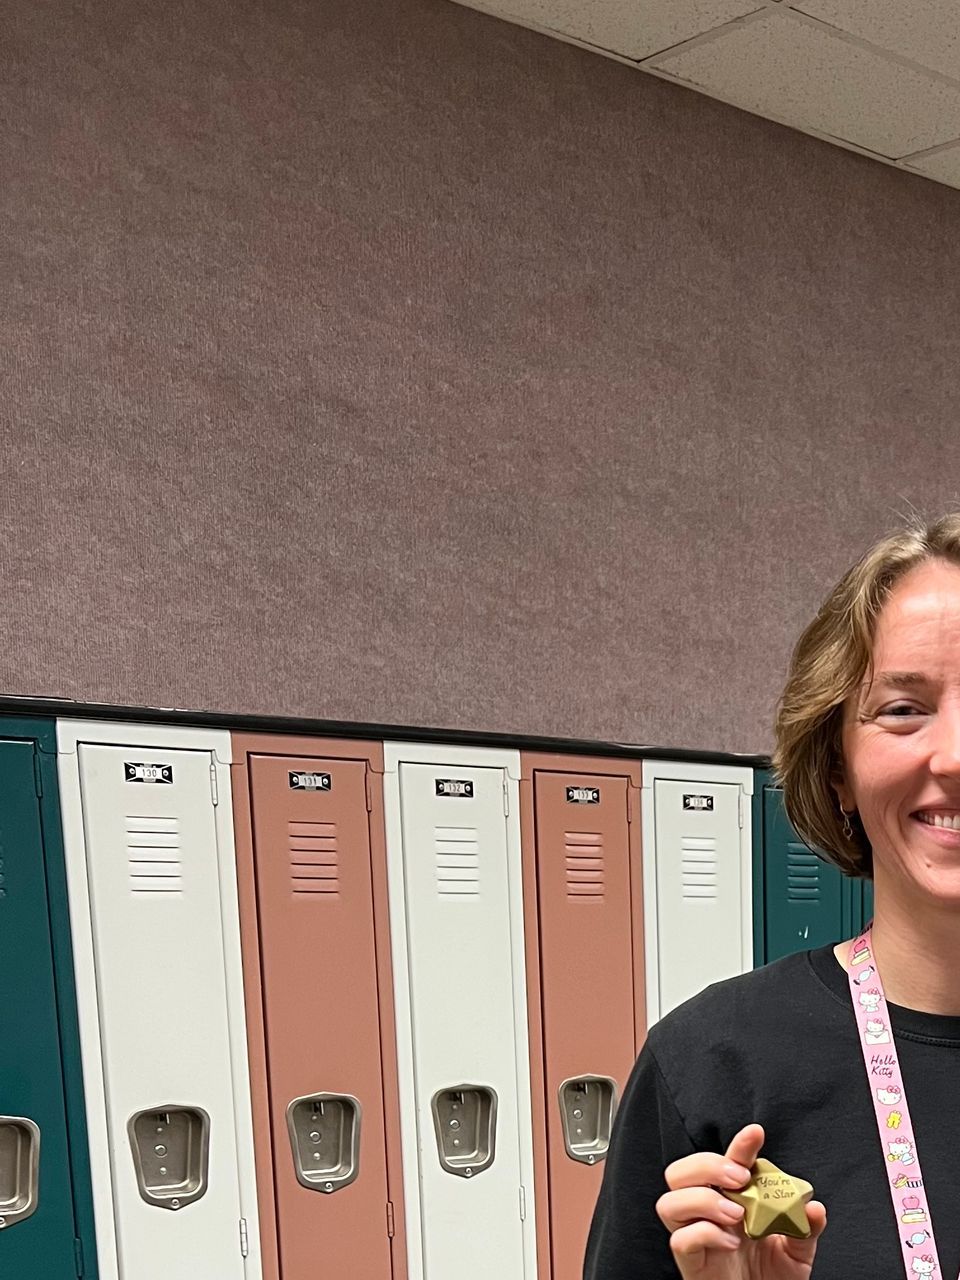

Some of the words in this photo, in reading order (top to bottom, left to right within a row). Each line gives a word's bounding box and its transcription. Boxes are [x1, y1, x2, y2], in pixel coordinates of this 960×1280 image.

[142, 768, 157, 778] 130
[870, 1055, 897, 1066] Hello
[871, 1065, 893, 1078] Kitty
[757, 1176, 791, 1188] You're
[763, 1192, 770, 1200] a
[772, 1189, 795, 1200] Star
